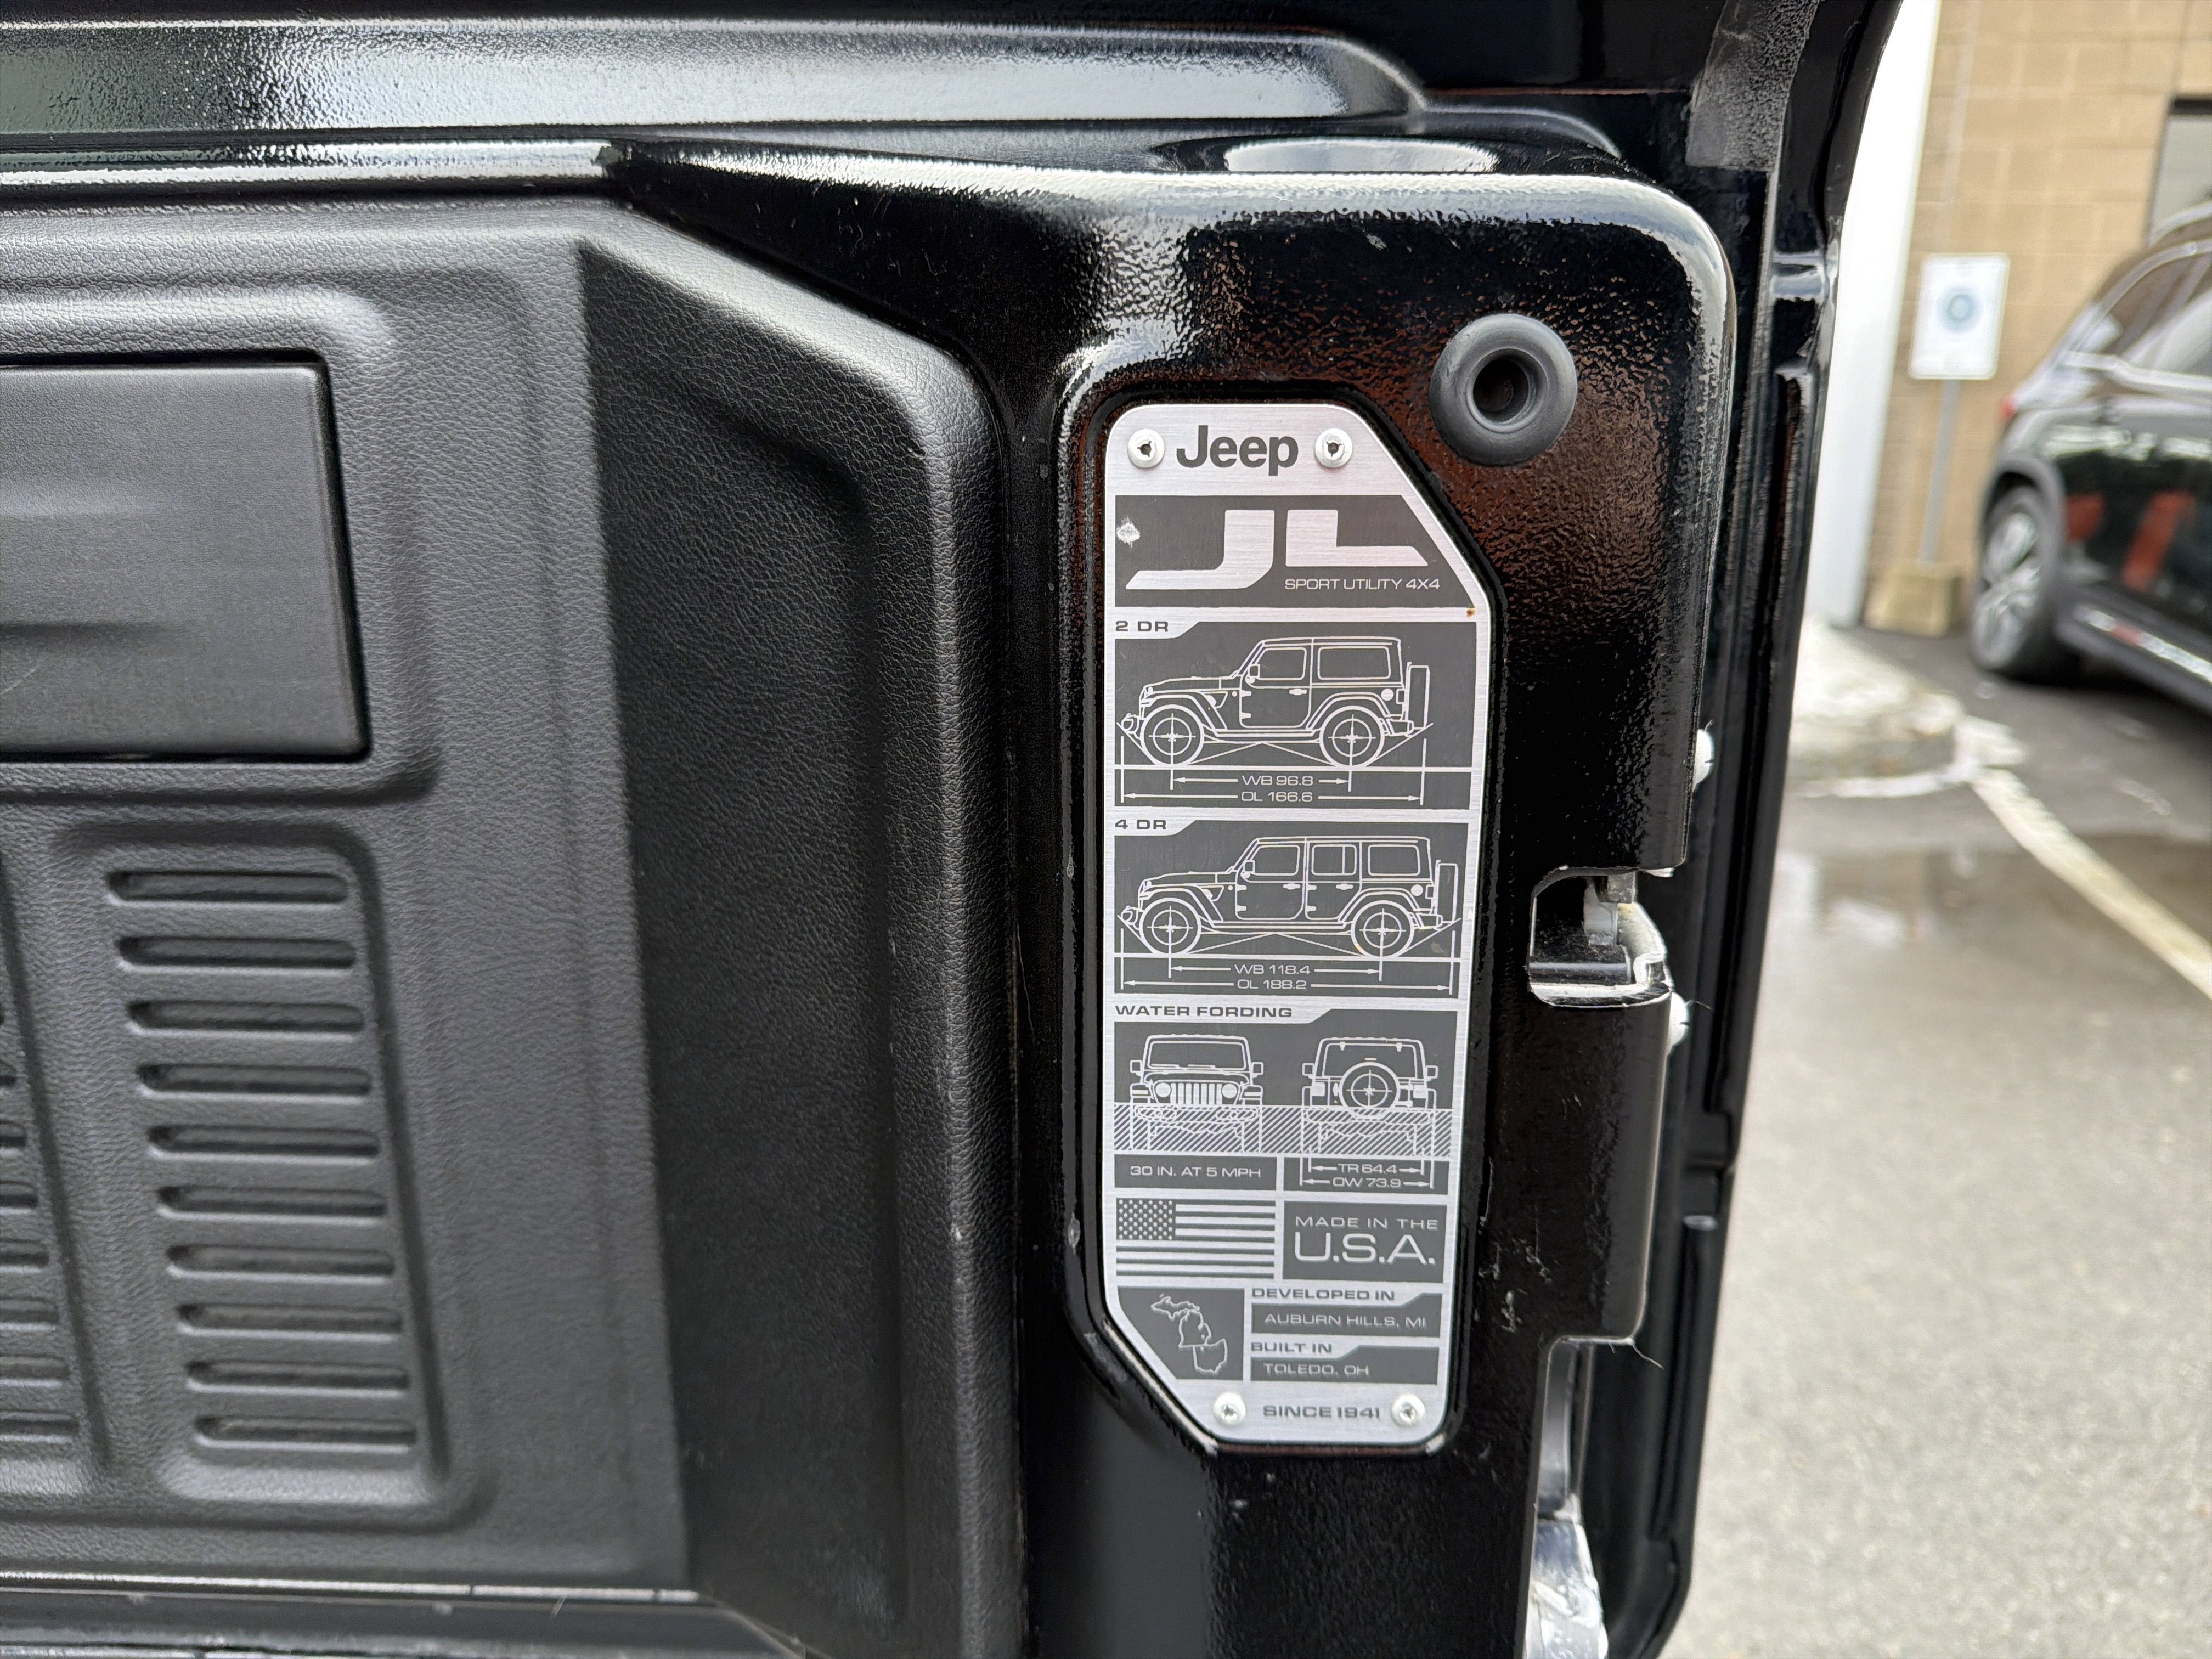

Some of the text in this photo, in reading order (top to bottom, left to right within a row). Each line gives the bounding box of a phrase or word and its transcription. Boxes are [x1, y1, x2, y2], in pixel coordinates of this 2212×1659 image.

[1176, 425, 1299, 477] Jeep
[1125, 509, 1429, 590] JL
[1285, 579, 1440, 590] SPORT UTILITY 4X4
[1115, 621, 1169, 633] 2 DR
[1242, 776, 1313, 786] WB 96.8
[1242, 792, 1313, 802] OL 166.6
[1115, 820, 1166, 830] 4 DR
[1234, 964, 1310, 975] WB 118.4
[1238, 979, 1307, 990] OL 188.2
[1115, 1005, 1292, 1018] WATER FORDING
[1130, 1166, 1261, 1178] 30 IN. AT 5 MPH
[1338, 1163, 1397, 1175] TR 64.4
[1333, 1177, 1401, 1188] OW 73.9
[1295, 1216, 1438, 1230] MADE IN THE
[1294, 1232, 1435, 1265] U.S.A.
[1251, 1288, 1395, 1301] DEVELOPED IN
[1264, 1313, 1425, 1328] AUBURN HILLS, MI
[1251, 1342, 1332, 1353] BUILT IN
[1263, 1363, 1369, 1376] TOLEDO, OH
[1263, 1406, 1380, 1419] SINCE 1941
